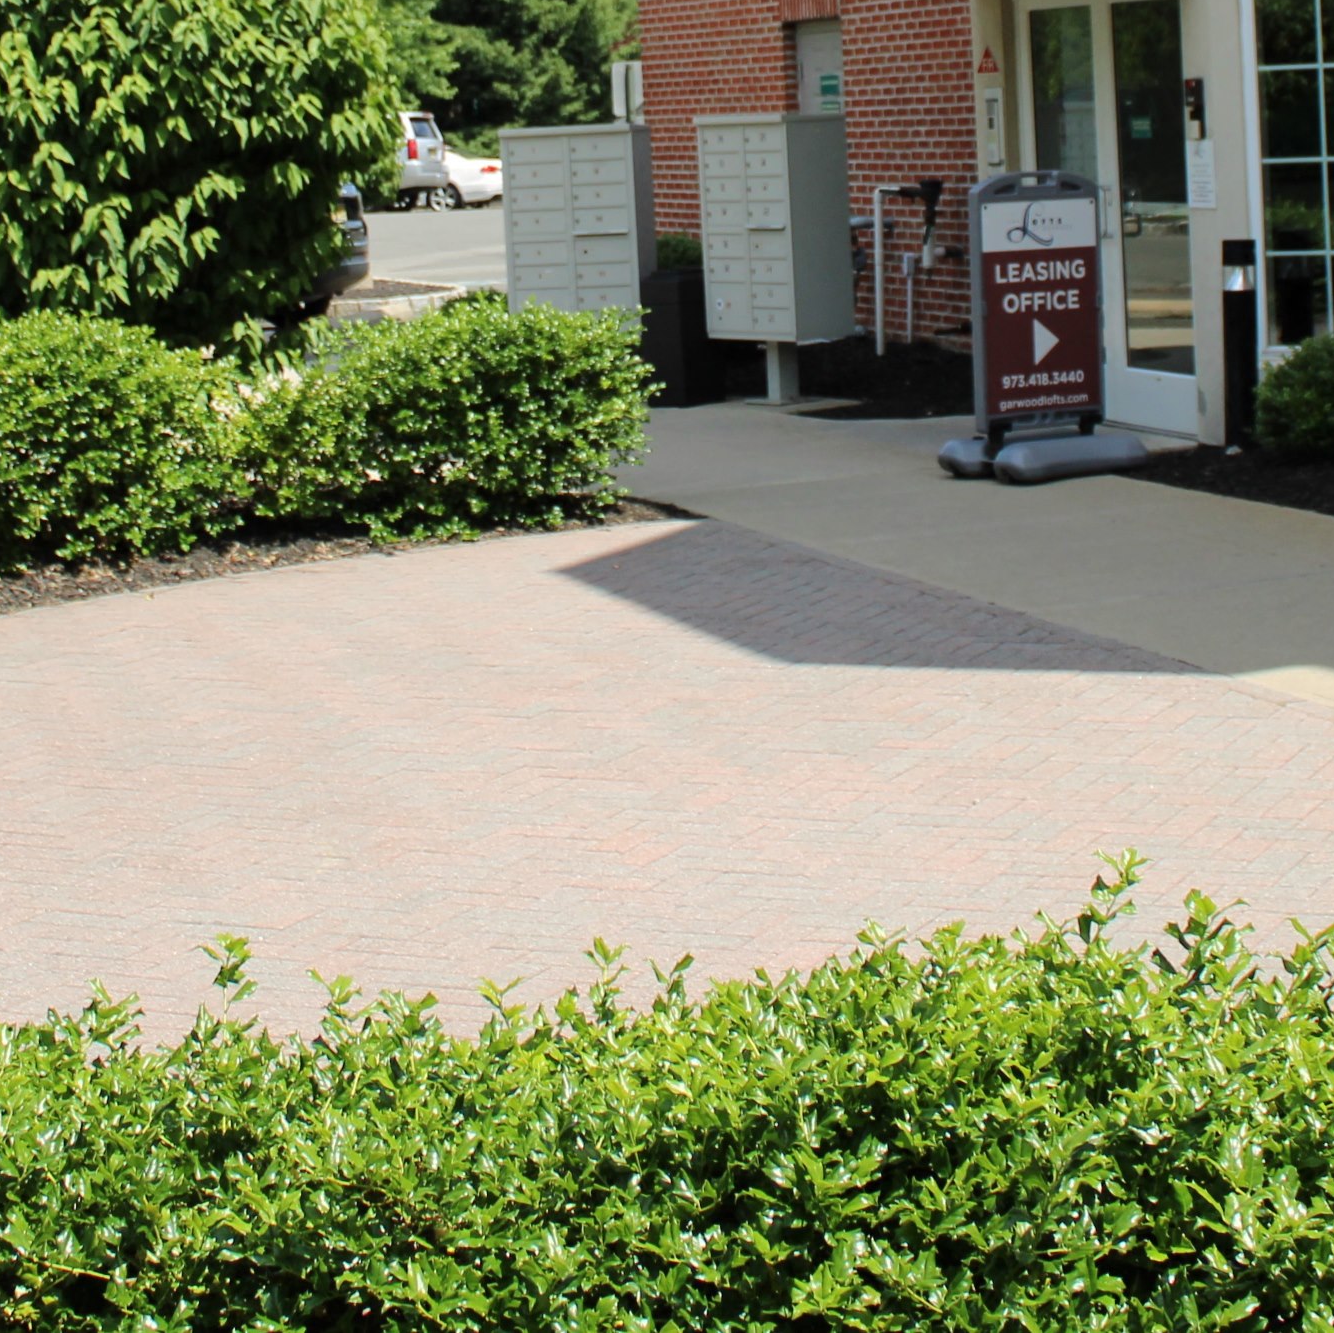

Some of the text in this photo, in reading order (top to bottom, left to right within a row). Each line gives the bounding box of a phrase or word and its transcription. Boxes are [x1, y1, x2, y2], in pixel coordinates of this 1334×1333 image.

[994, 258, 1086, 284] LEASING
[1002, 289, 1081, 314] OFFICE
[1001, 369, 1085, 389] 973.418.3440
[999, 393, 1089, 412] garwoodlofts.com
